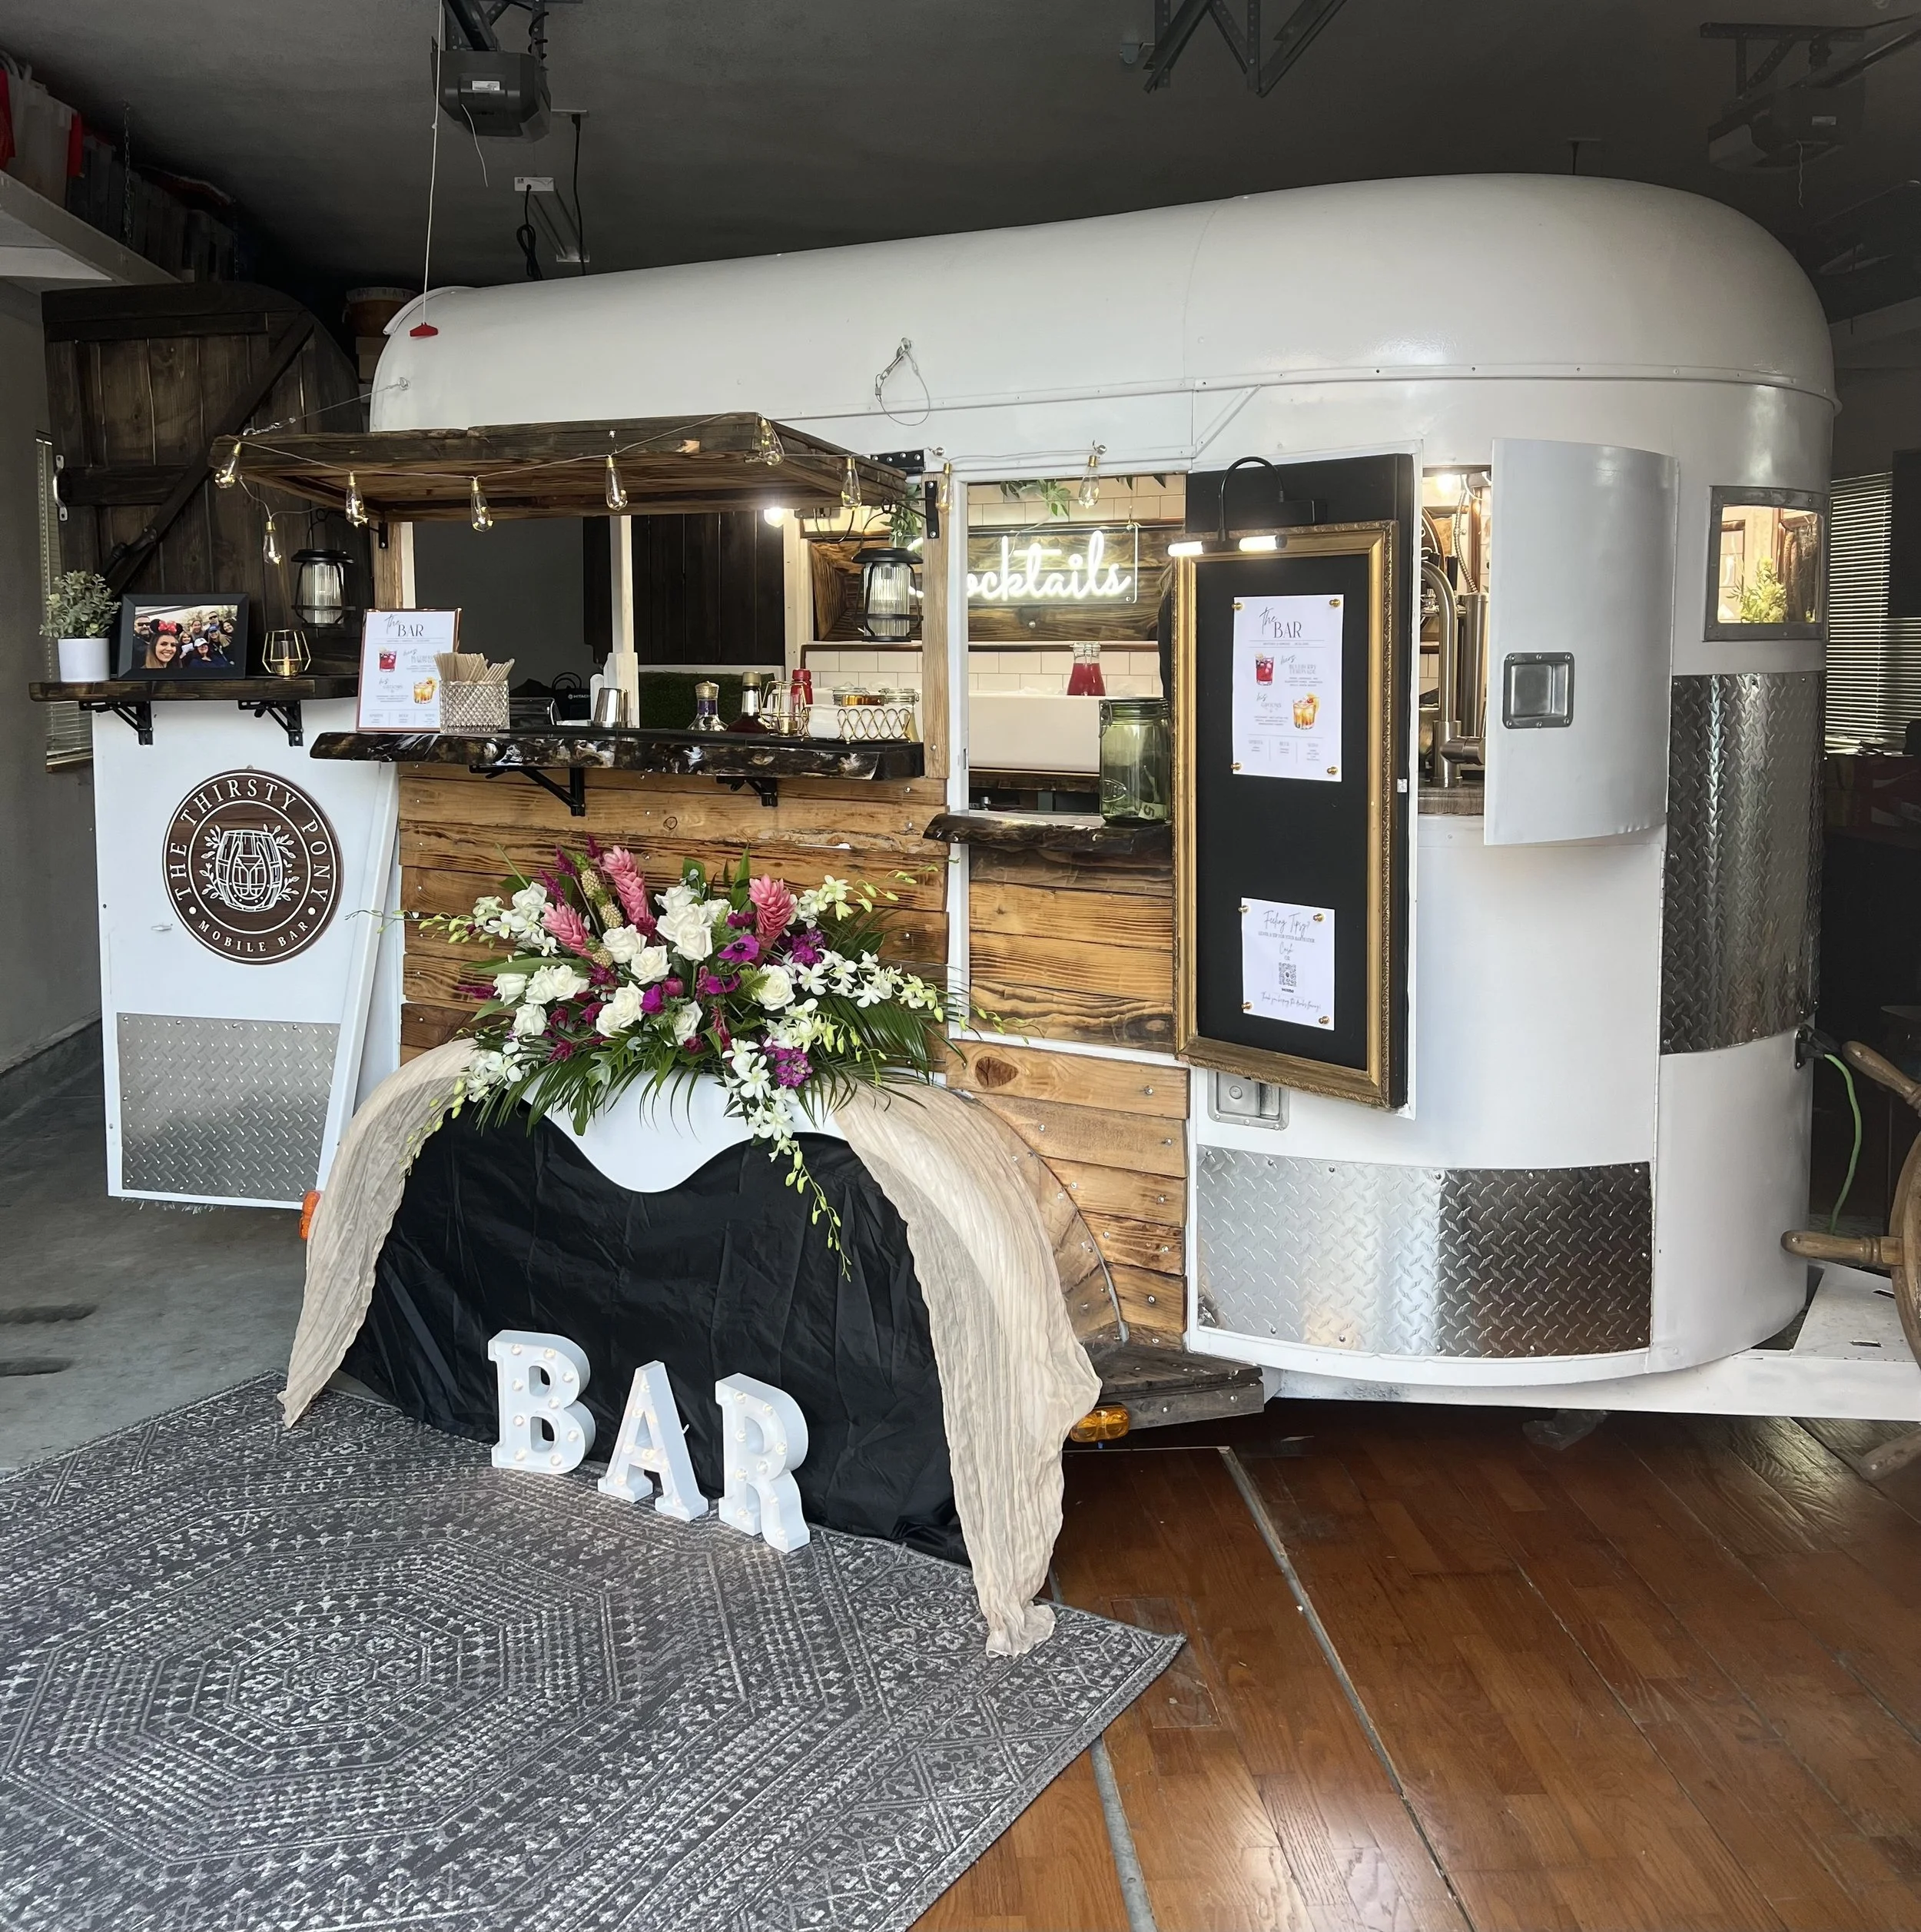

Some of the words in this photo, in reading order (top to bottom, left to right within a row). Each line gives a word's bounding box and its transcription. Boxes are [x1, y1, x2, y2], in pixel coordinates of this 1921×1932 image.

[966, 529, 1132, 602] ocktails
[398, 624, 424, 636] BAR
[1274, 621, 1302, 638] BAR
[180, 778, 297, 826] THIRSTY
[170, 842, 192, 901] THE
[301, 819, 330, 901] PONY
[198, 920, 266, 952] MOBILE
[277, 921, 309, 947] BAR
[1263, 910, 1287, 933] Feeling
[488, 1329, 810, 1553] BAR
